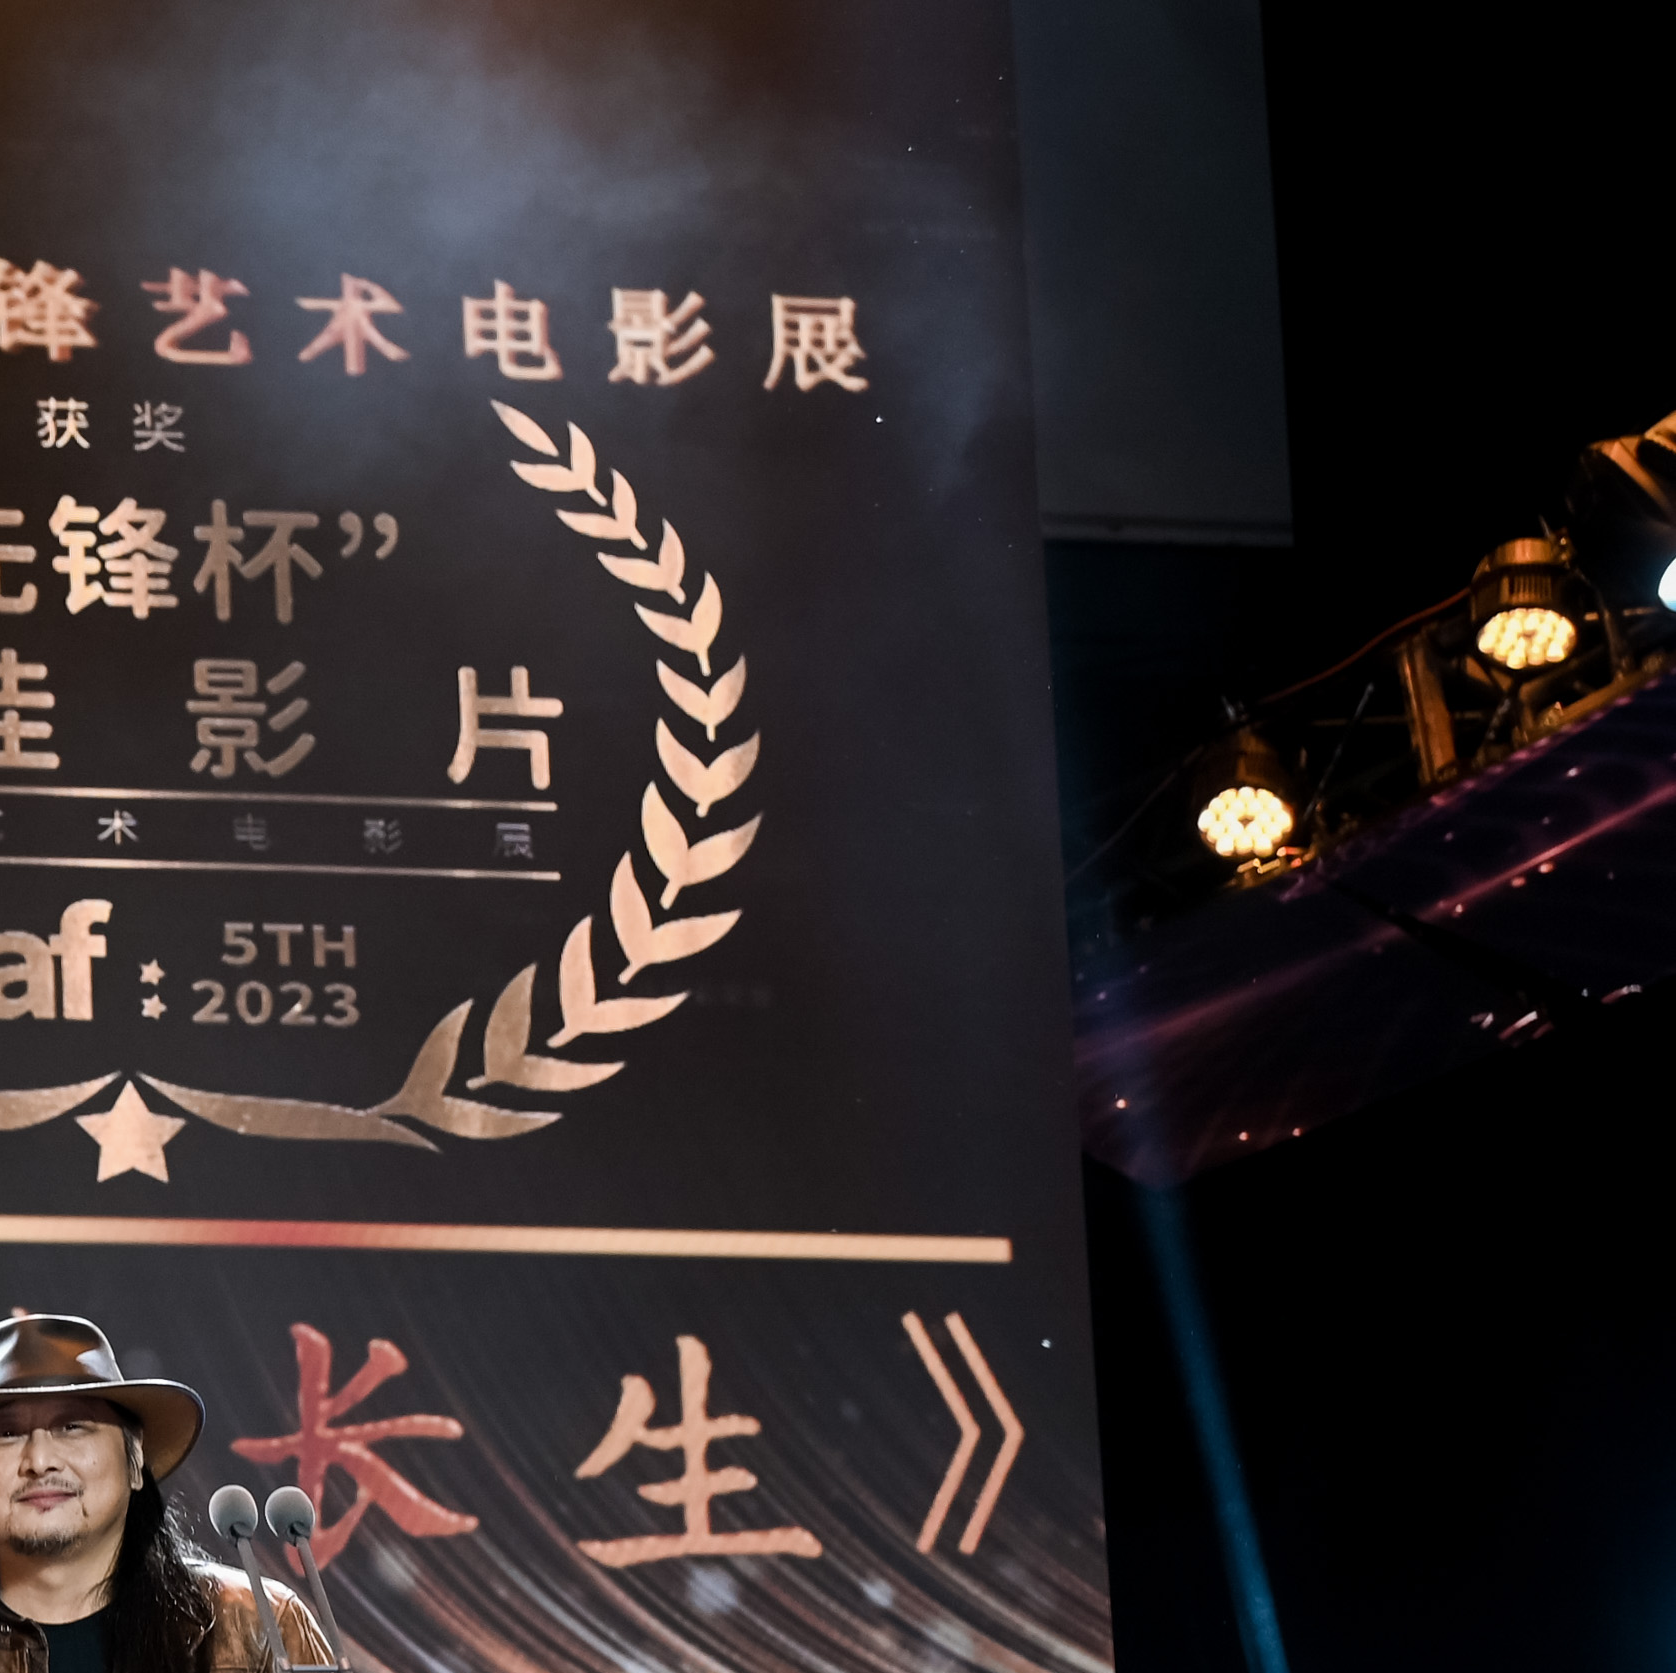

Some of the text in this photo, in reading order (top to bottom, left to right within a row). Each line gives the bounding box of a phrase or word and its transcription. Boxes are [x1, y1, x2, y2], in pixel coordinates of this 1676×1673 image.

[35, 396, 185, 454] 获奖
[222, 921, 358, 969] 5TH
[191, 979, 360, 1027] 2023
